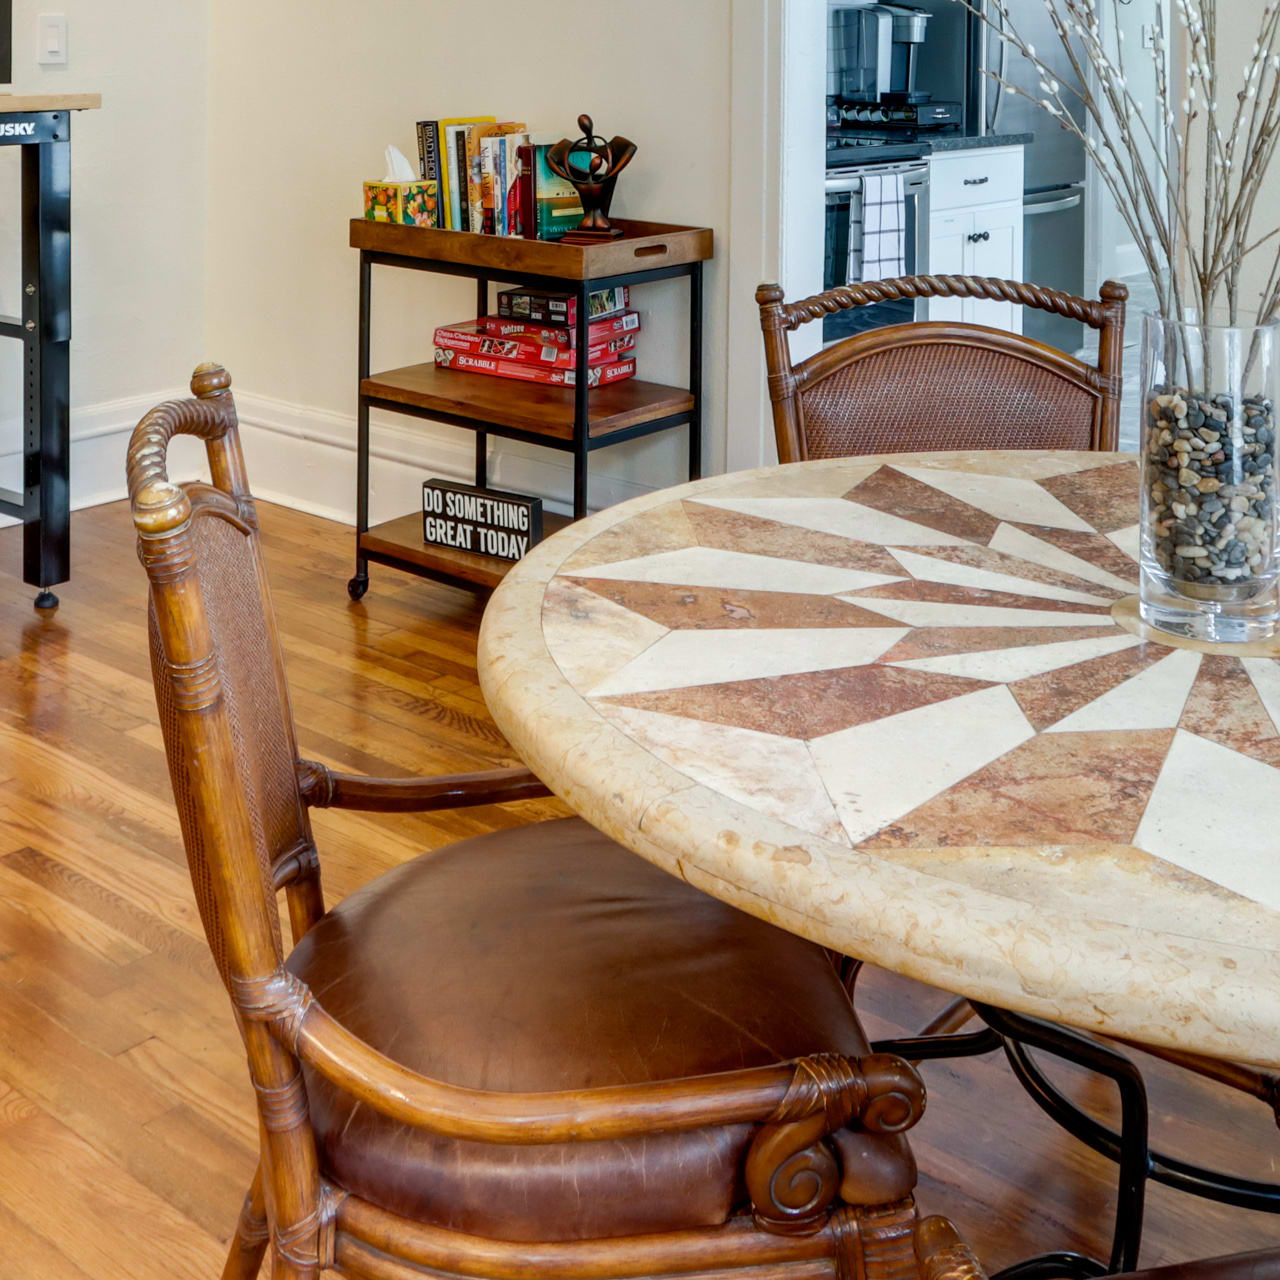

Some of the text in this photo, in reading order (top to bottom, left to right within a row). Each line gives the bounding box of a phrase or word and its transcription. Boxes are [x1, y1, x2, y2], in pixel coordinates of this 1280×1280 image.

[425, 125, 434, 150] BRAD
[500, 325, 525, 335] Yahtzee
[458, 355, 496, 370] SCRABBLE
[423, 487, 529, 531] DO SOMETHING
[425, 516, 528, 560] GREAT TODAY
